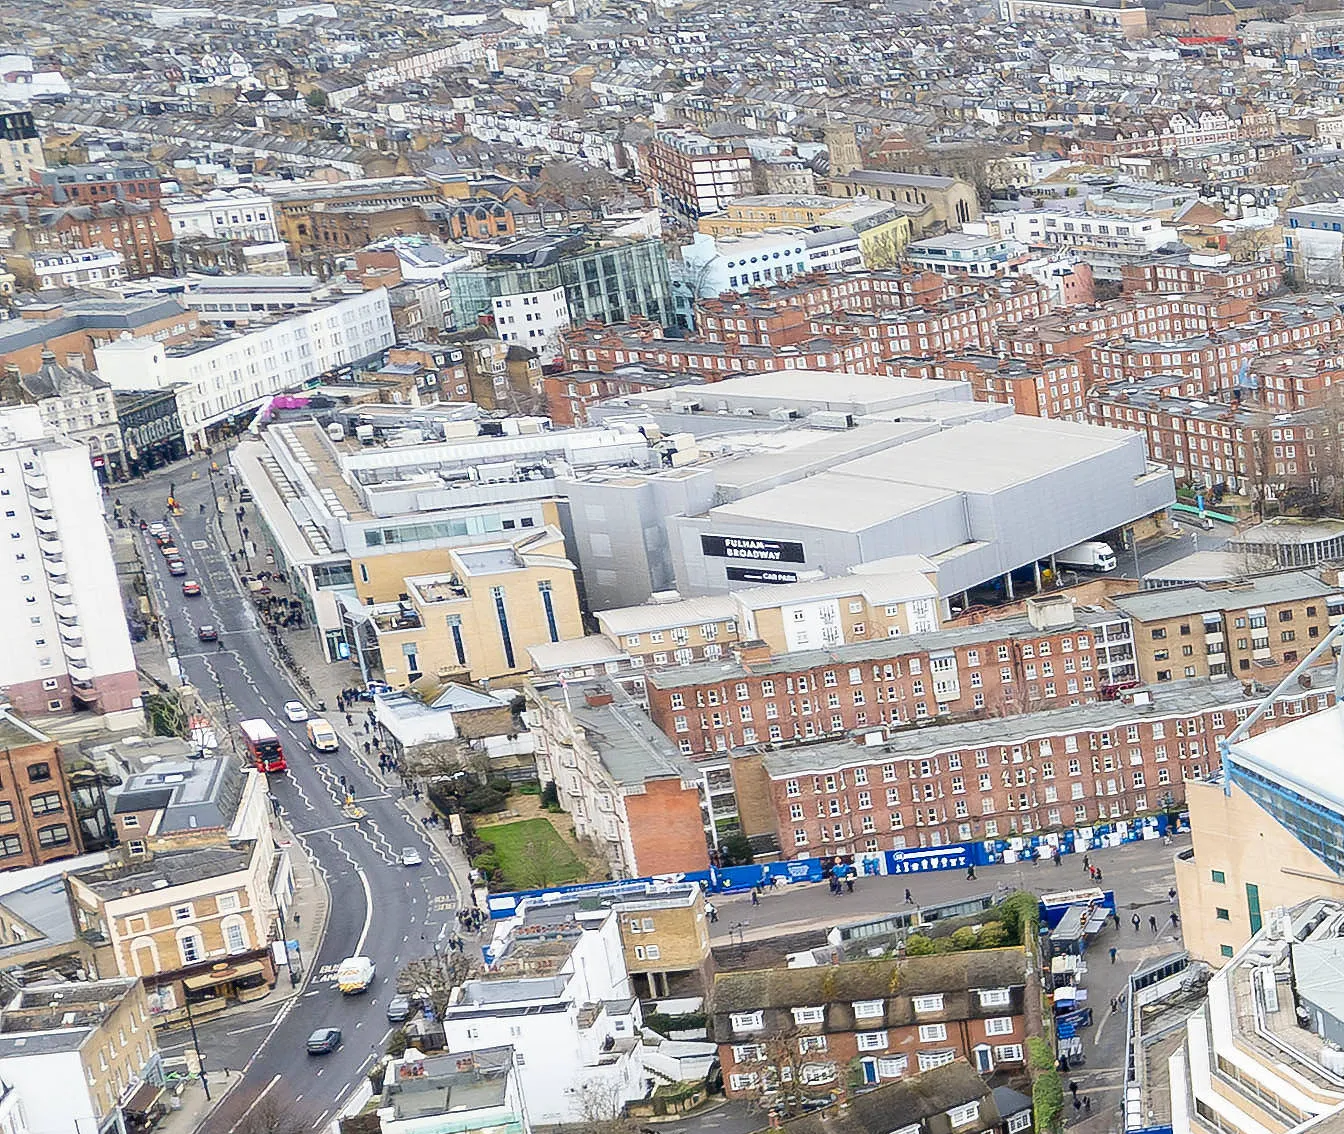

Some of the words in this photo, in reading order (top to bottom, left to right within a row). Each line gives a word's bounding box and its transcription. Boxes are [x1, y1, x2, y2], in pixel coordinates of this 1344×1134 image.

[724, 538, 766, 549] FULHAM
[727, 548, 781, 560] BROADWAY
[762, 573, 777, 581] CAR
[778, 574, 797, 582] PARK
[311, 975, 340, 984] LAN
